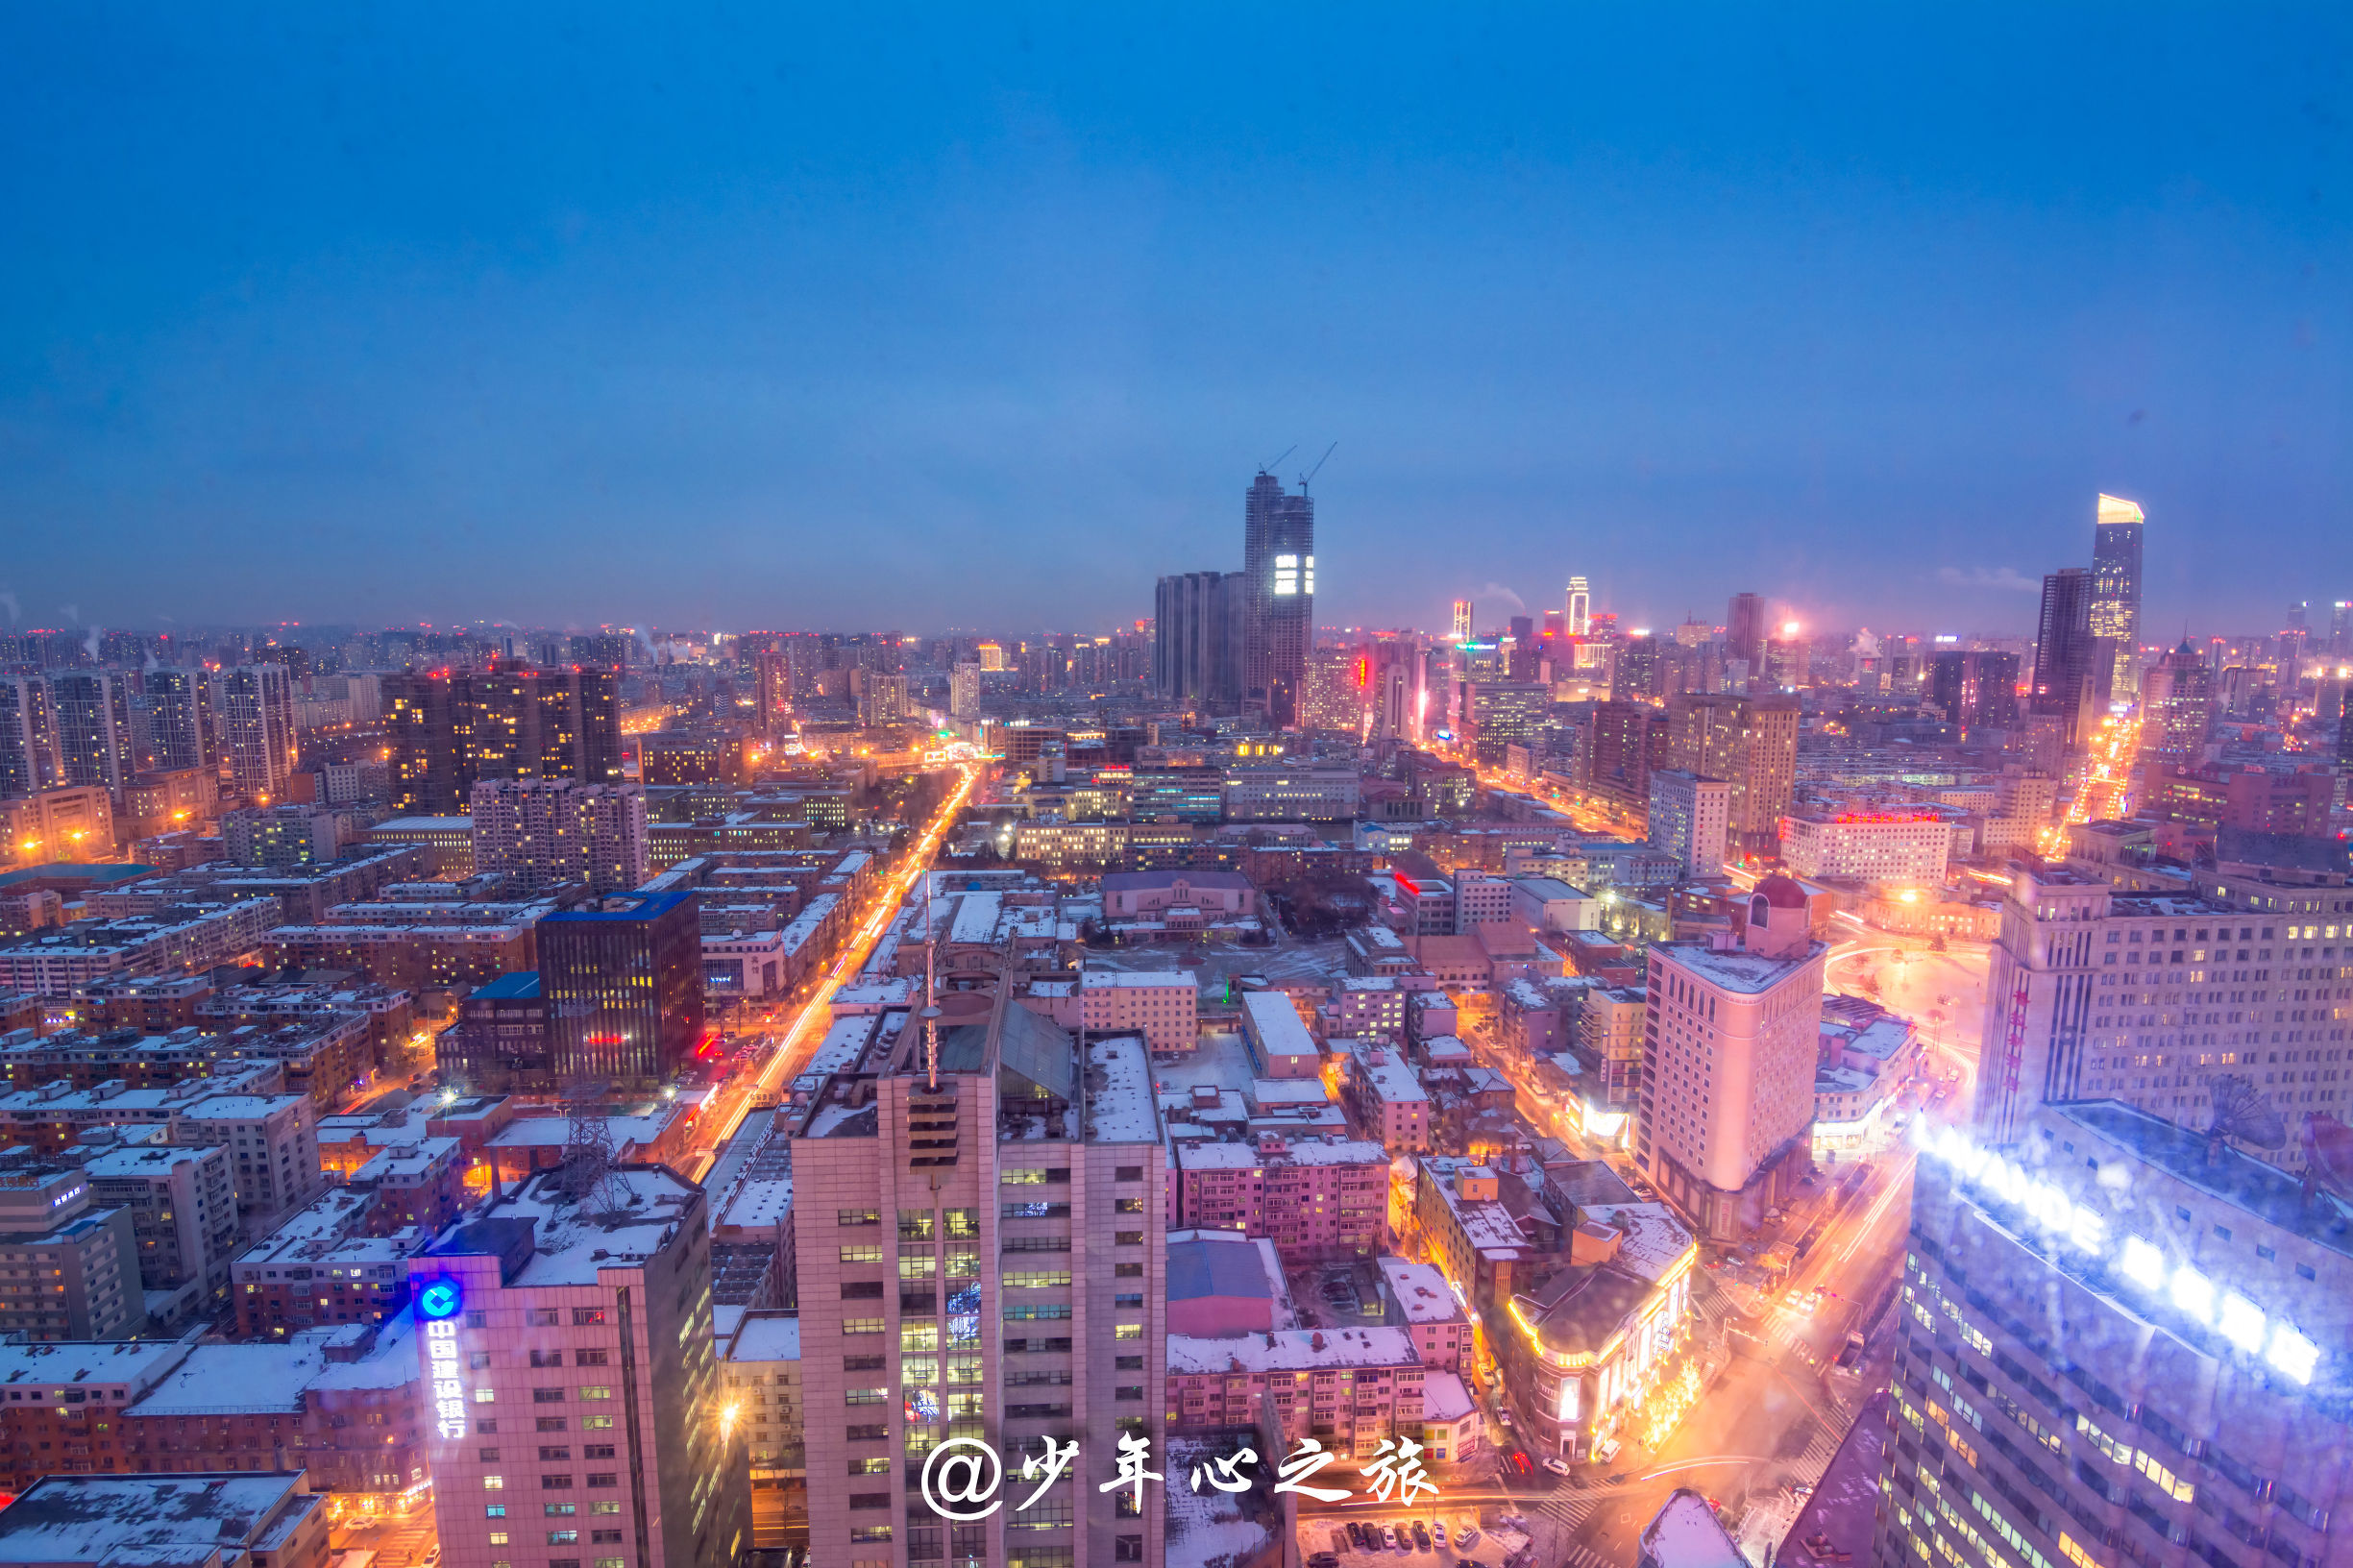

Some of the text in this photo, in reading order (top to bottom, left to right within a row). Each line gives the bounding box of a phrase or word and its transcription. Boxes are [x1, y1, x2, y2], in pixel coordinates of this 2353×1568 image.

[428, 1320, 465, 1438] 中国建设银行
